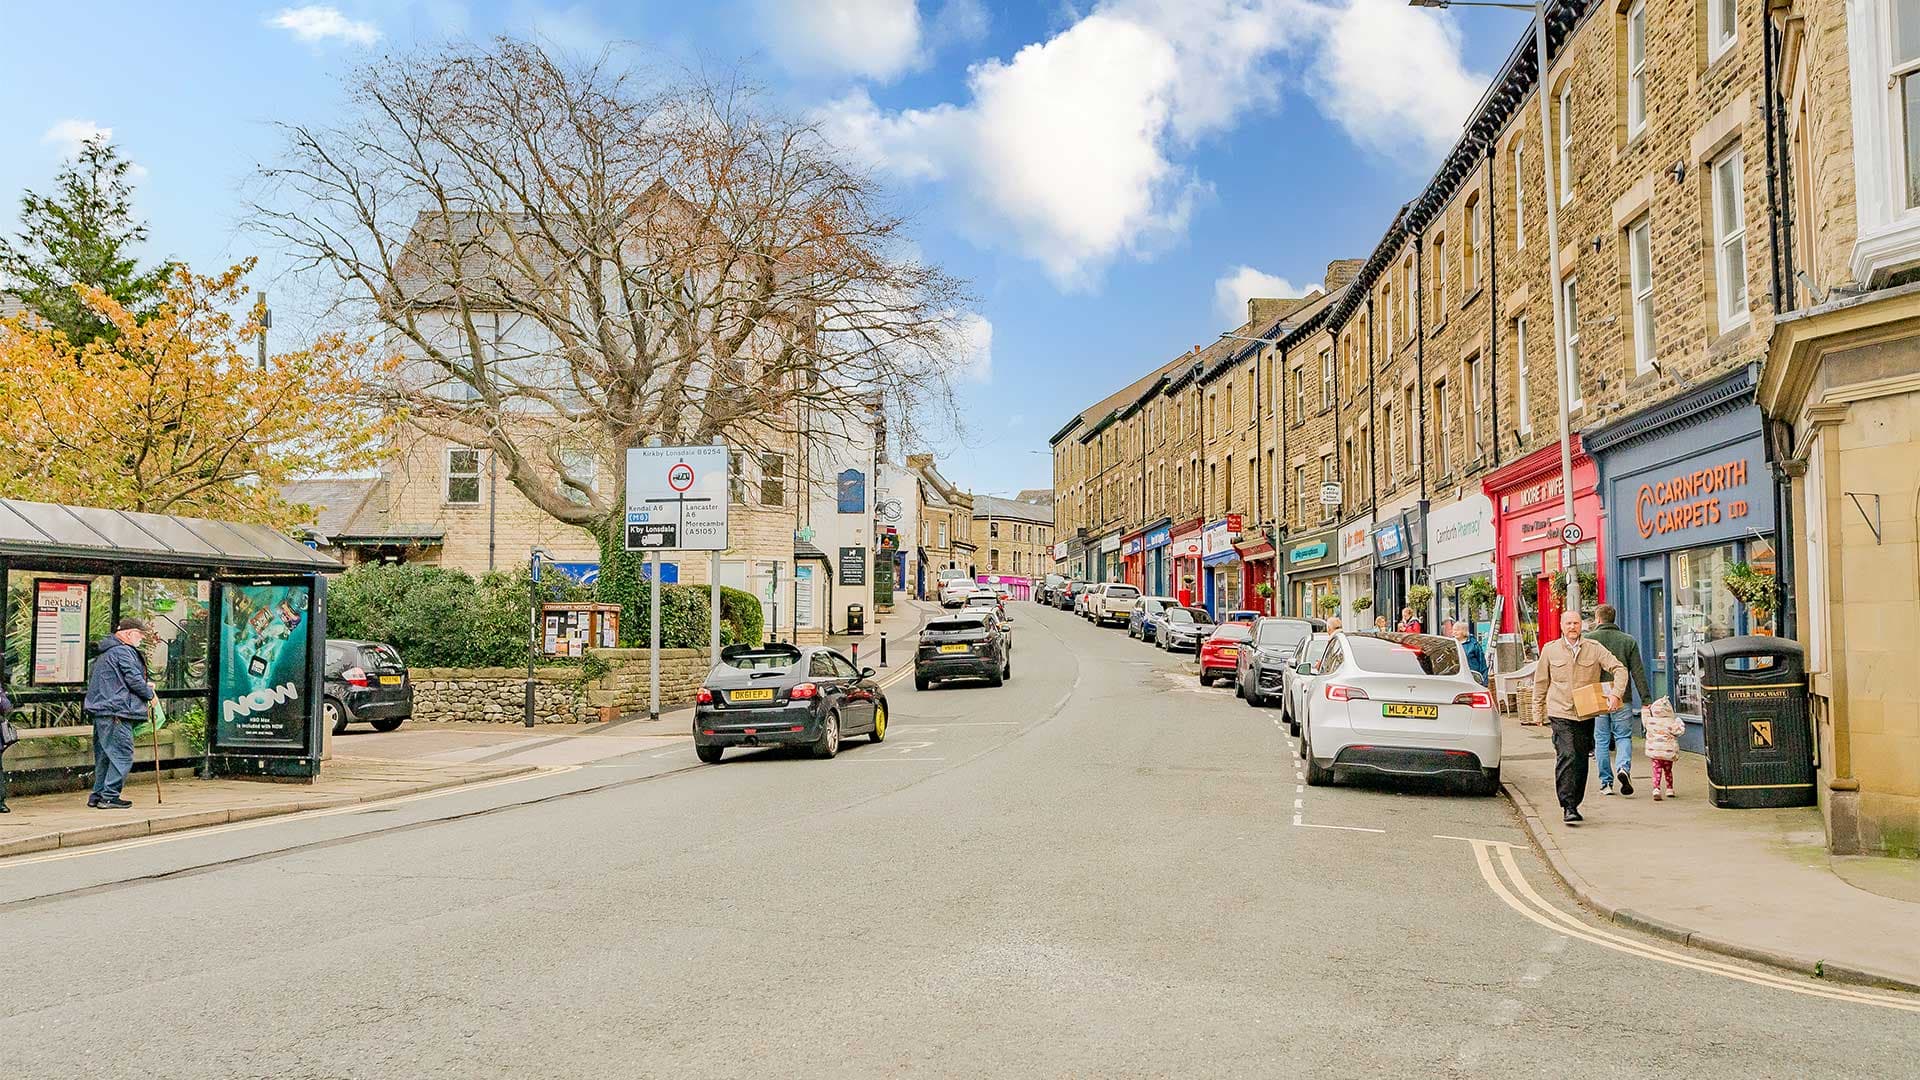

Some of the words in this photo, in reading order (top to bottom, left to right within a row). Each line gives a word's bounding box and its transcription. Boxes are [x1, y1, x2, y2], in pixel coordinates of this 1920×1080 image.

[642, 450, 663, 458] Kirkby
[665, 449, 695, 457] Lonsdale
[1655, 458, 1748, 506] CARNFORTH
[628, 504, 651, 512] Kendal
[629, 513, 649, 521] (M6)
[1655, 497, 1721, 534] CARPETS
[1727, 500, 1748, 519] LTD
[685, 520, 725, 528] Morecambe
[630, 526, 644, 535] K'by
[646, 525, 675, 534] Lonsdale
[1435, 523, 1457, 544] Carnforth
[1565, 529, 1580, 539] 20
[44, 598, 64, 607] next
[64, 598, 83, 608] bus?
[222, 682, 299, 722] NOW
[1388, 705, 1414, 715] ML24
[1416, 706, 1436, 716] PVZ
